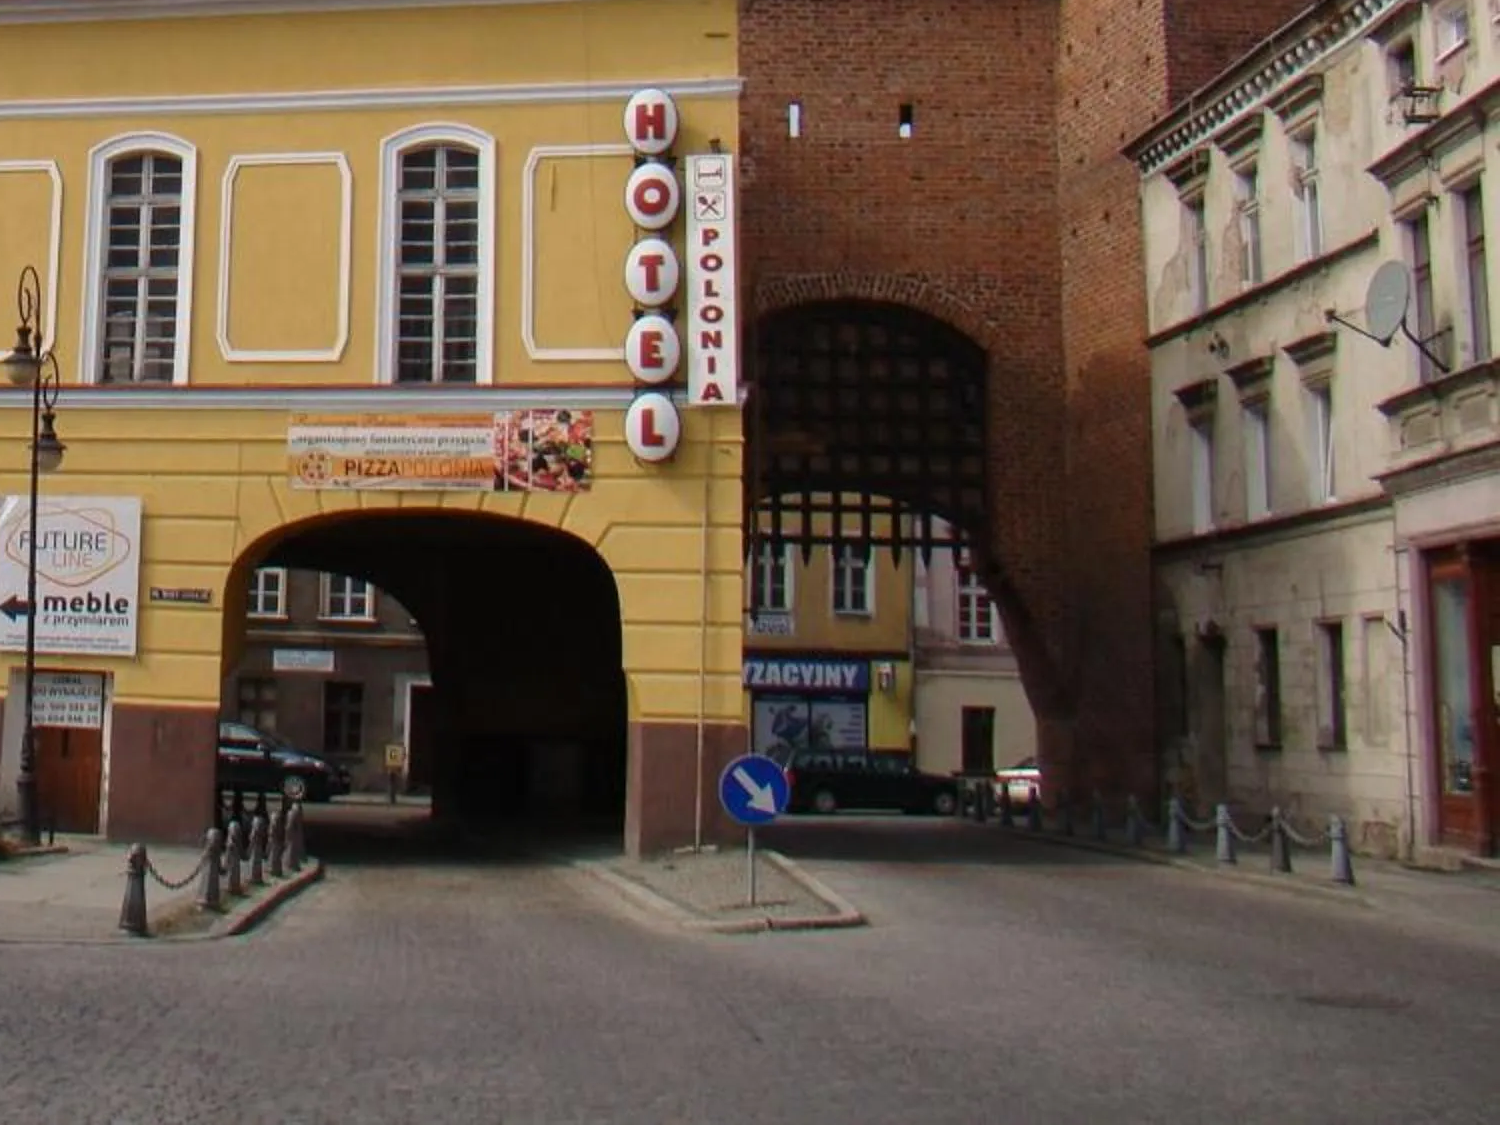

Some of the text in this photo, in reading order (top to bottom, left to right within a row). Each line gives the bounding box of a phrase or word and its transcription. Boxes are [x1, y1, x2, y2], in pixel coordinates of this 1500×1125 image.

[632, 102, 671, 448] HOTEL
[698, 227, 725, 402] POLONIA
[344, 458, 400, 476] PIZZA
[19, 530, 107, 553] FUTURE
[51, 551, 94, 569] LINE
[43, 591, 130, 615] meble
[52, 613, 130, 628] przymiarem
